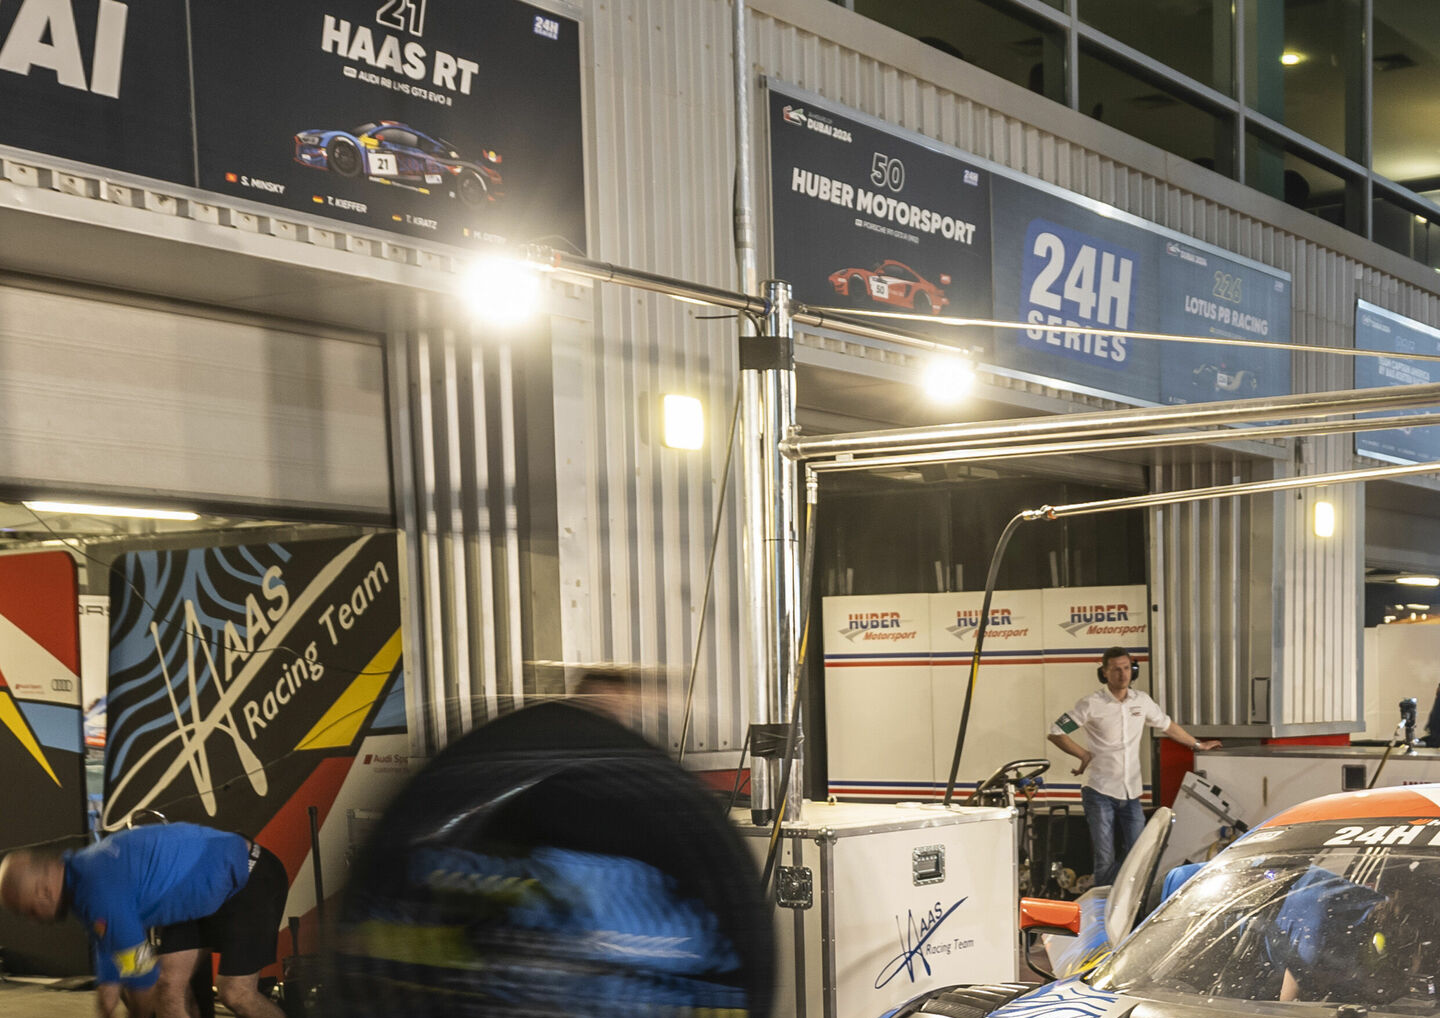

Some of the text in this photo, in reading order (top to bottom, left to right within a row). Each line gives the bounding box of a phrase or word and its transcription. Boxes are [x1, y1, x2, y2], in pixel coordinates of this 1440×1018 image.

[321, 14, 479, 95] HAAS RT
[358, 70, 379, 86] AUDI
[377, 158, 390, 171] 21
[870, 151, 905, 193] 50
[791, 167, 976, 245] HUBER MOTORSPORT
[1028, 231, 1133, 330] 24H
[1213, 271, 1243, 304] 226
[1185, 295, 1217, 320] LOTUS
[1218, 306, 1231, 324] PB
[1232, 310, 1268, 336] RACING
[1026, 308, 1127, 363] SERIES
[849, 612, 901, 630] HUBER
[1070, 604, 1129, 624] HUBER
[863, 630, 917, 643] Motorsport
[1086, 625, 1147, 638] Motorsport
[244, 561, 390, 740] Racing Team
[1323, 826, 1427, 848] 24H
[926, 938, 975, 955] Racing Team
